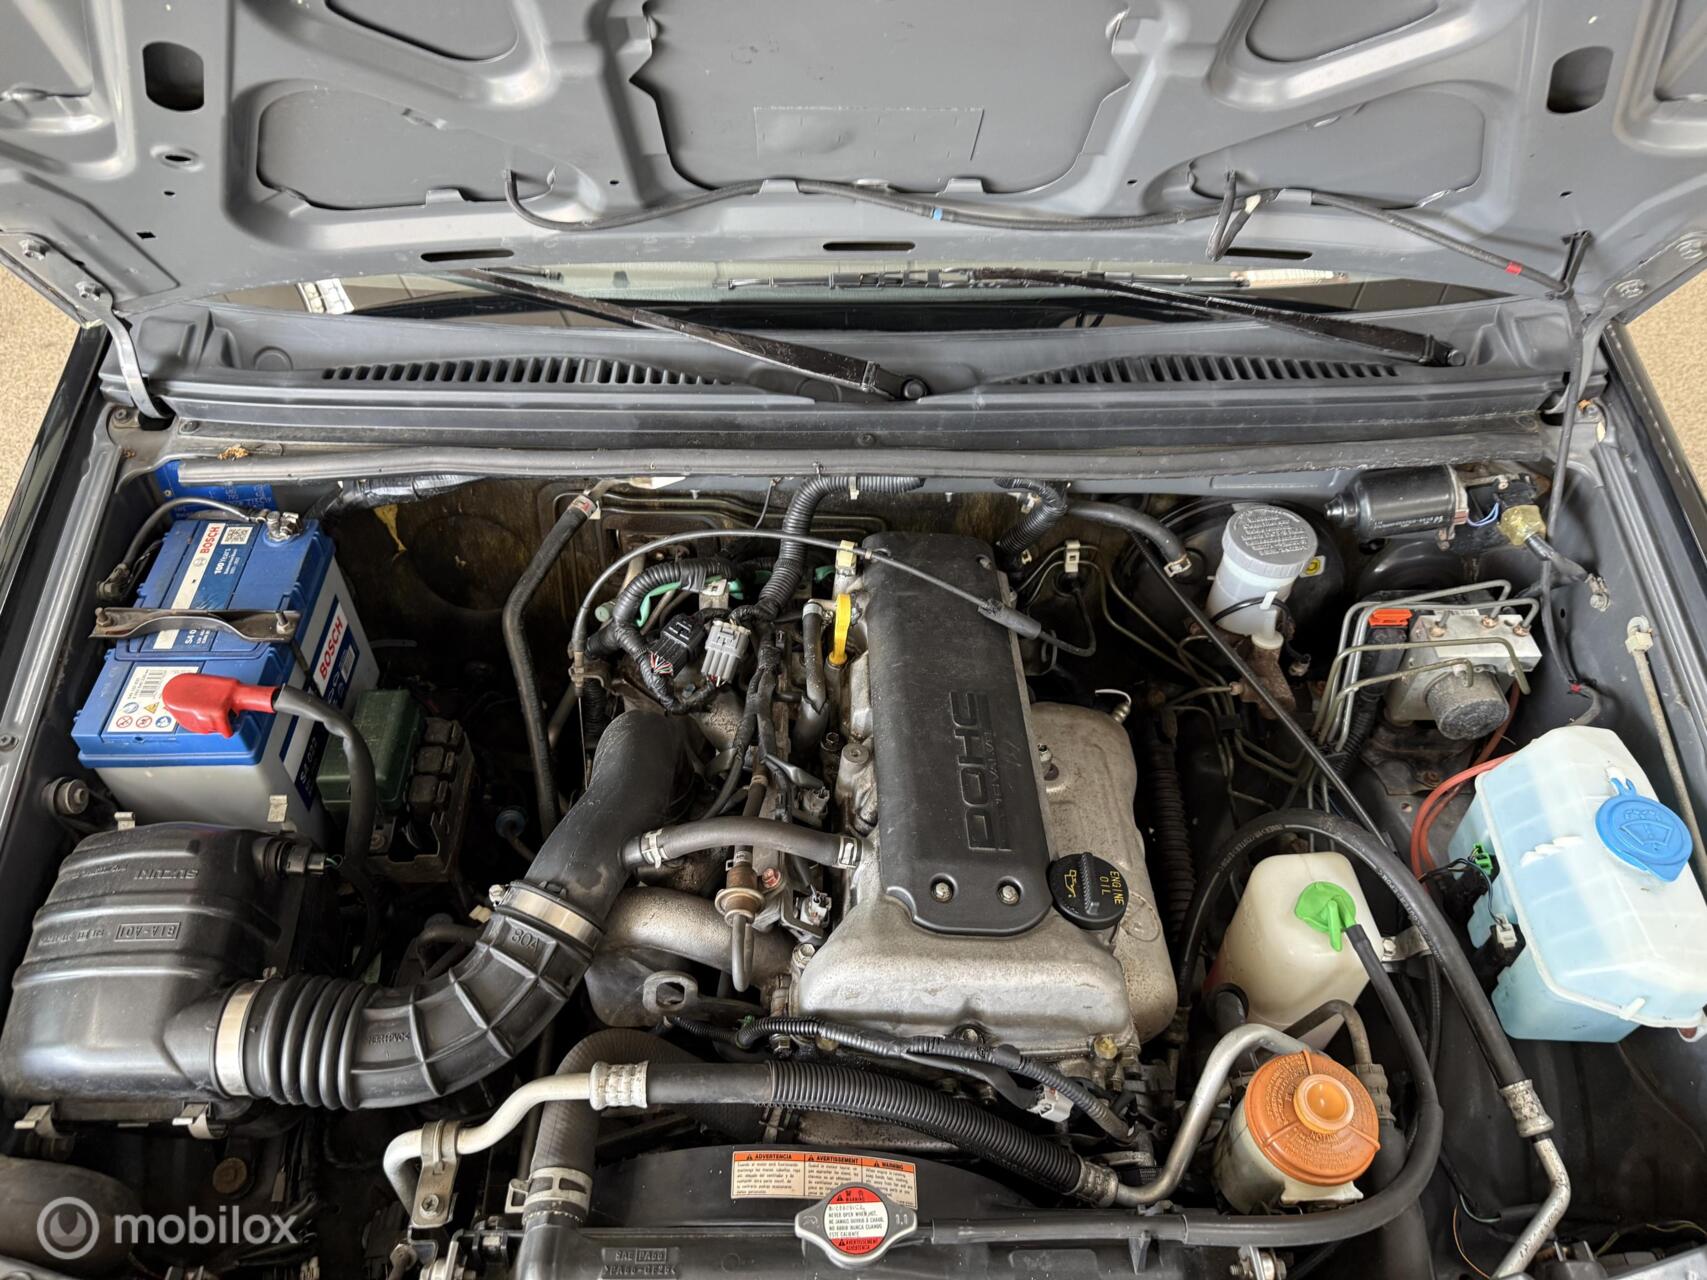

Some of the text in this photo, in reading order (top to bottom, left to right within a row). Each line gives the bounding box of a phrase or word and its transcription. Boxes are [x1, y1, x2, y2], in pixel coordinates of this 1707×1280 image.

[200, 526, 220, 554] BOSCH
[320, 616, 343, 681] BOSCH
[949, 690, 1011, 852] DOHC
[1099, 876, 1111, 896] OIL
[1110, 870, 1125, 906] ENGINE
[816, 1155, 859, 1164] AVERTISSEMENT
